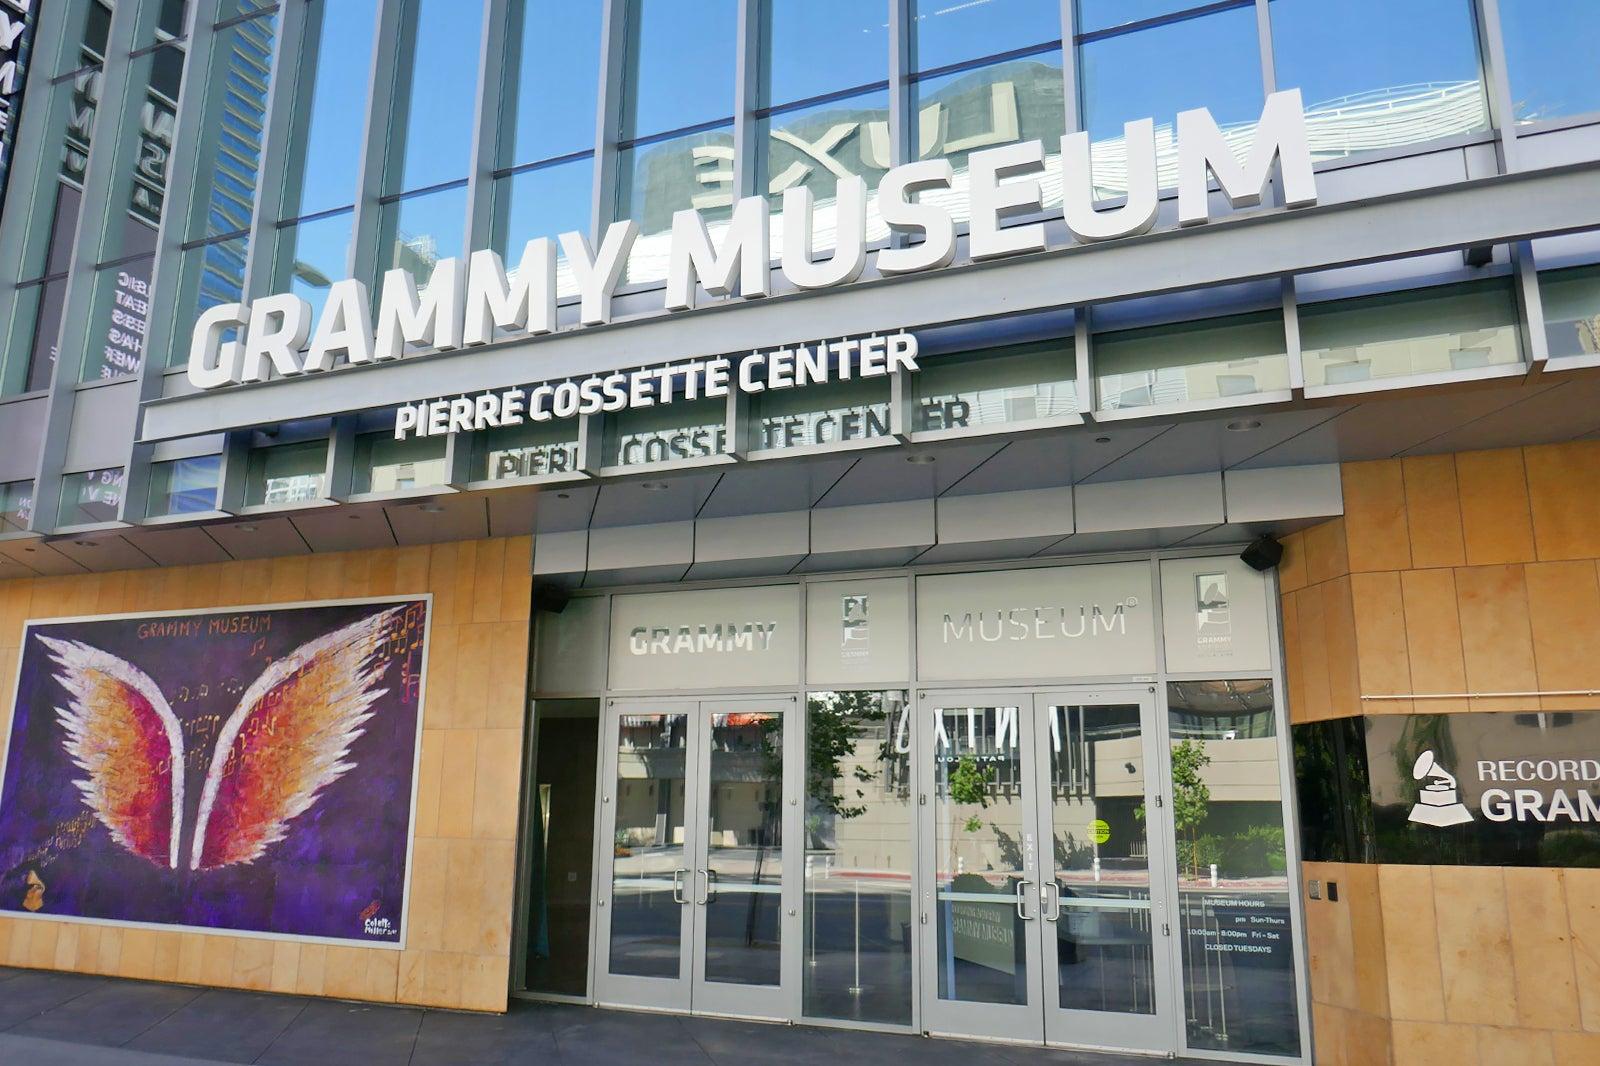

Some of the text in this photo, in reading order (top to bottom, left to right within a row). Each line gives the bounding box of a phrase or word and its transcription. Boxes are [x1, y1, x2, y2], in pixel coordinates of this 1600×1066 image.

[187, 87, 1317, 389] GRAMMY MUSEUM
[394, 333, 920, 440] PIERRE COSSETTE CENTER
[137, 615, 271, 639] GRAMMY MUSEUM
[630, 602, 1126, 656] GRAMMY MUSEUM
[1477, 759, 1600, 781] RECORD
[1026, 833, 1034, 871] EXIT
[1203, 899, 1265, 908] MUSEUM HOURS
[1252, 931, 1261, 939] Fri
[1267, 931, 1280, 940] Sat
[1205, 943, 1272, 954] CLOSED TUESDAYS
